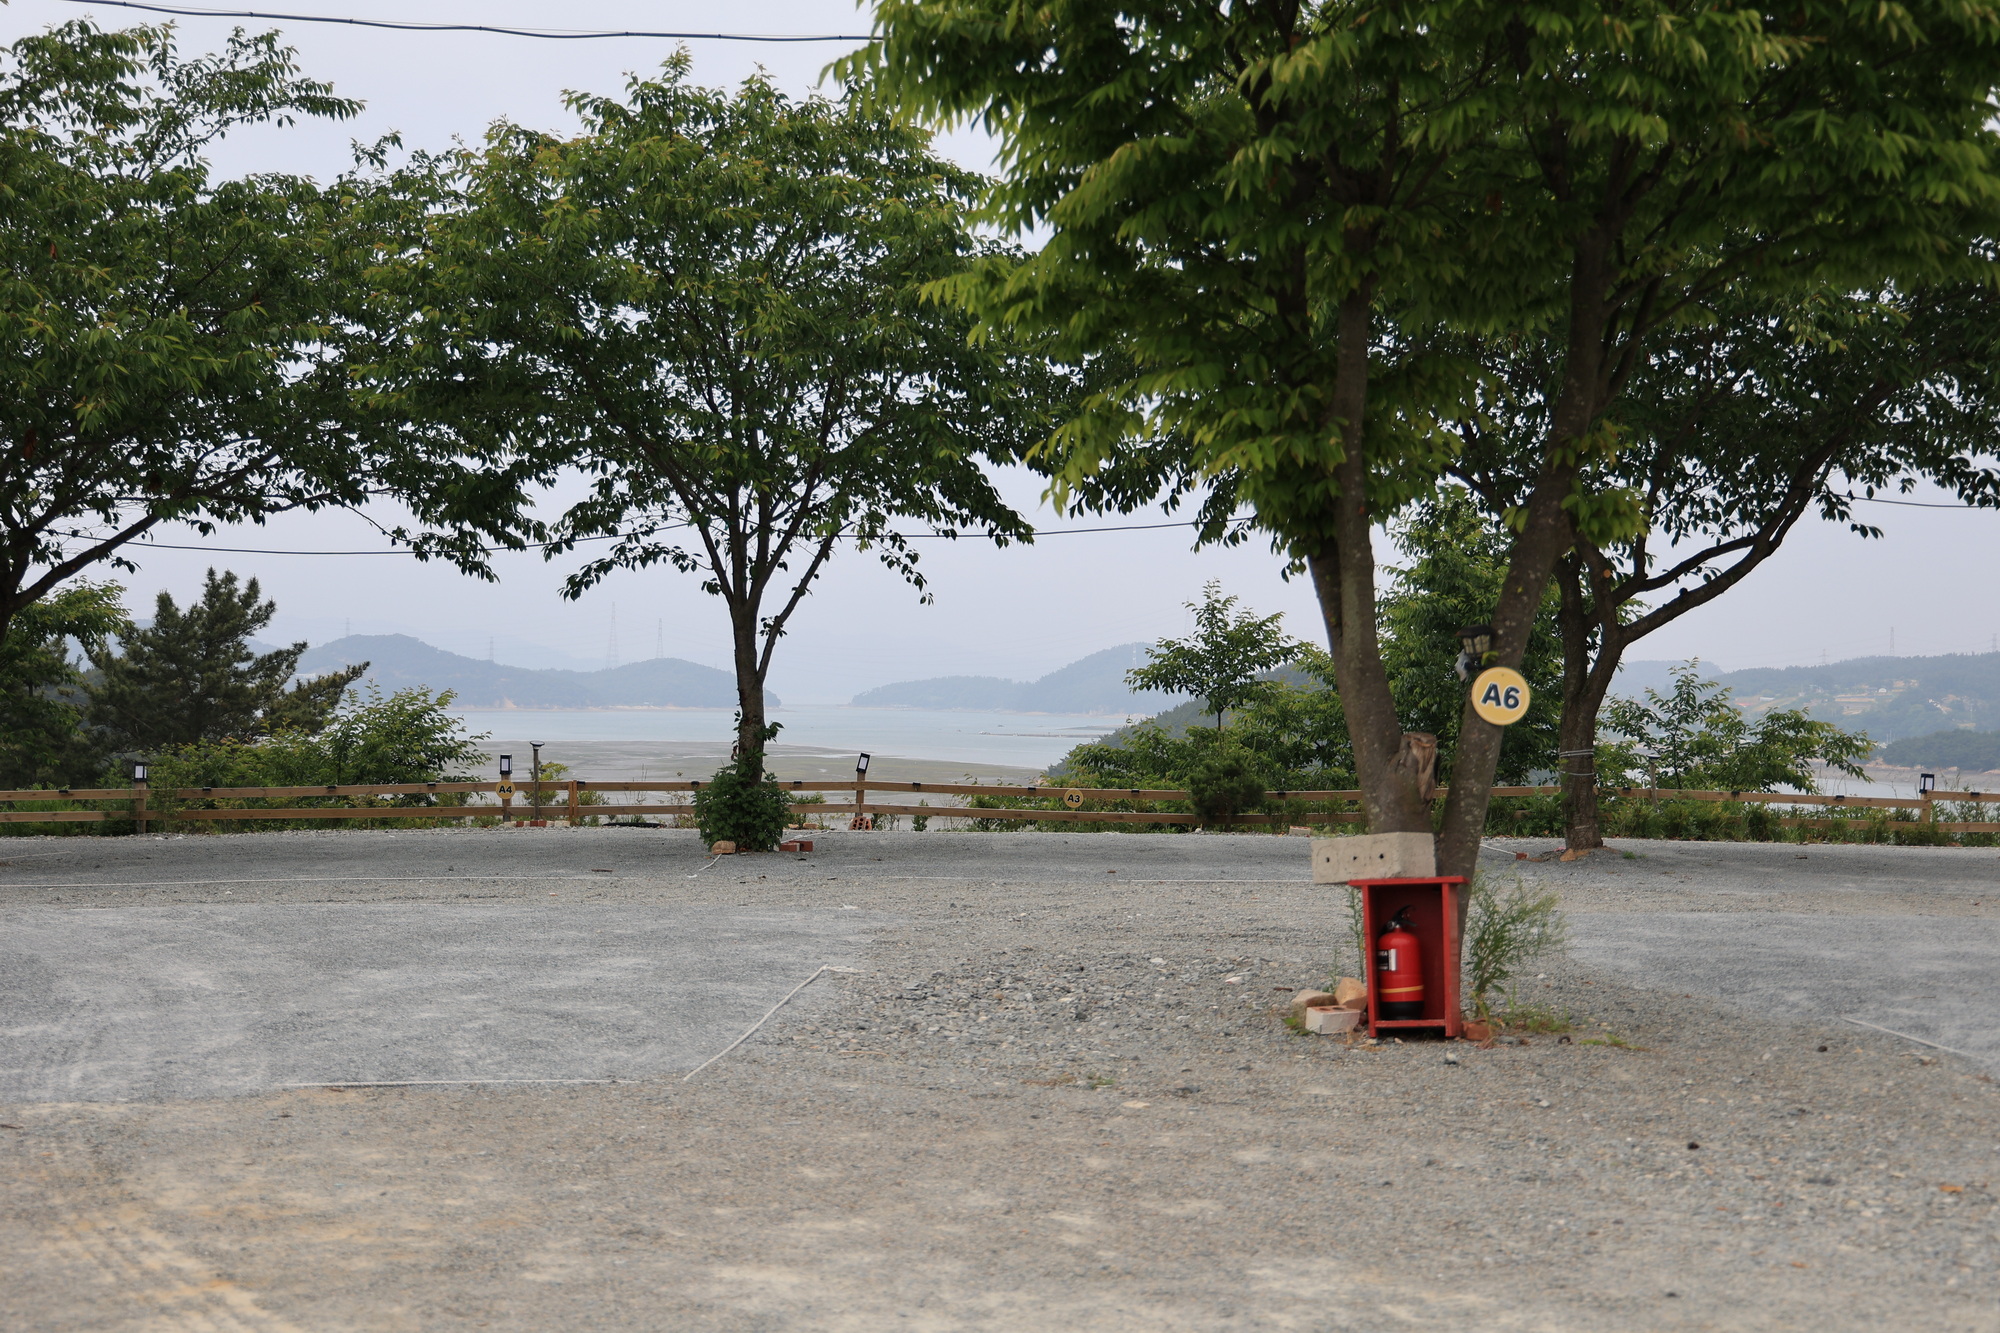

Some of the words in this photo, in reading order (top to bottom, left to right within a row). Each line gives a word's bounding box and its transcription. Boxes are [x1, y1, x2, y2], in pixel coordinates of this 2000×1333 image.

[1481, 682, 1520, 710] A6
[499, 785, 512, 793] A4
[1067, 794, 1080, 803] A3
